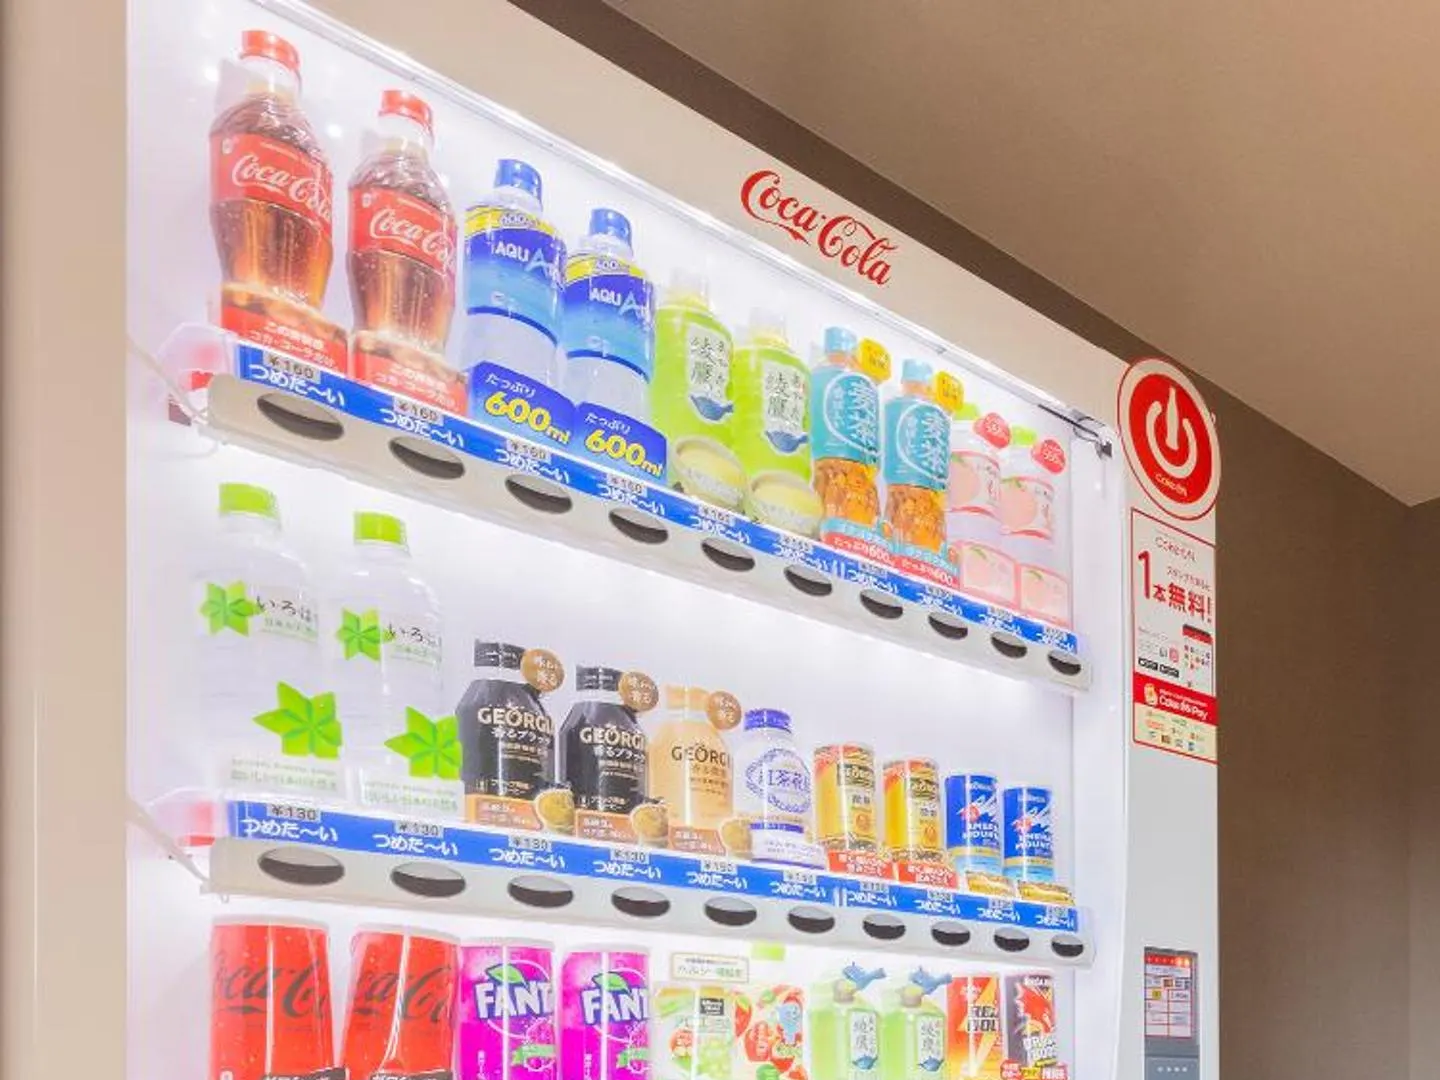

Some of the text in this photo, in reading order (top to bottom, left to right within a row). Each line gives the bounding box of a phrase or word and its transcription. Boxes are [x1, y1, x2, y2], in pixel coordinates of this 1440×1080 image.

[741, 169, 898, 286] Coca-Cola
[484, 391, 571, 446] 600ml
[583, 428, 664, 478] 600ml
[579, 726, 646, 750] GEORGI
[671, 744, 731, 768] GEORGI
[270, 805, 317, 821] ¥130
[474, 980, 554, 1020] FANT
[580, 984, 650, 1024] FANT
